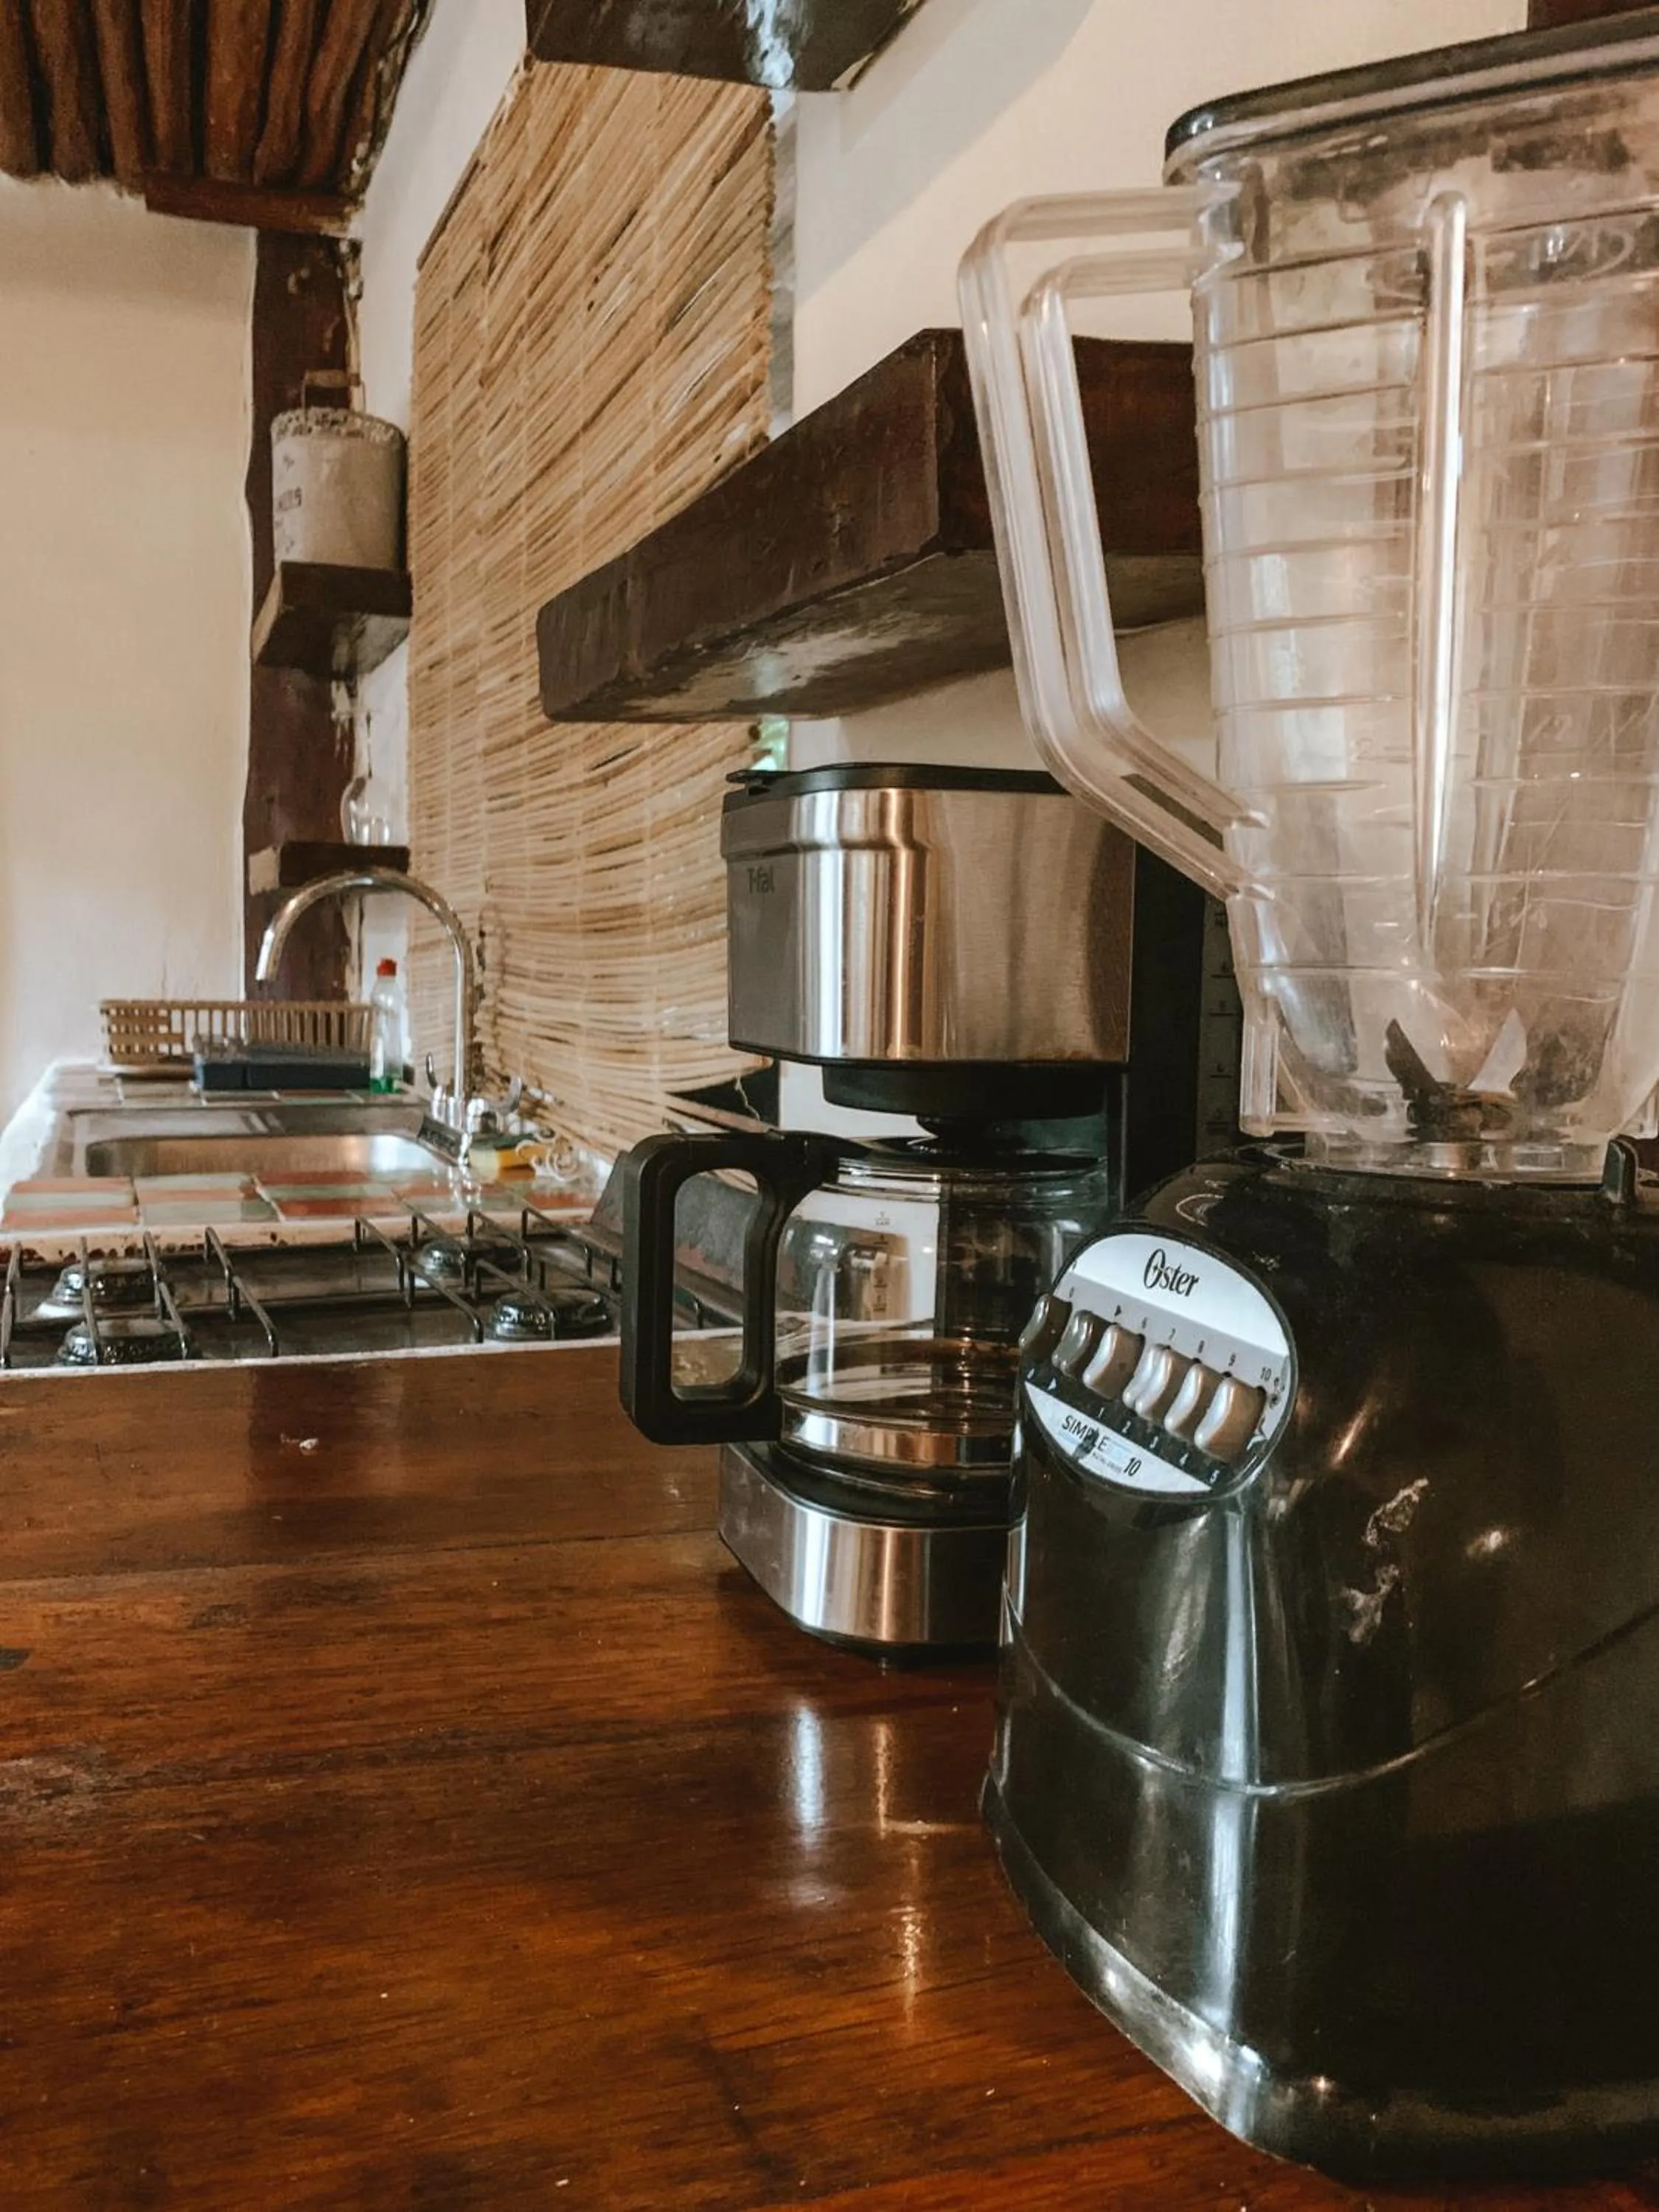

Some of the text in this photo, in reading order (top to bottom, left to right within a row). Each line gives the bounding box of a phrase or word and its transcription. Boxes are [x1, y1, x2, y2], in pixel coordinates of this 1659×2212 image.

[1144, 1248, 1200, 1297] Oster
[1228, 1353, 1237, 1366] 9
[1259, 1366, 1273, 1381] 10
[1121, 1420, 1132, 1433] 2
[1123, 1457, 1142, 1477] 10
